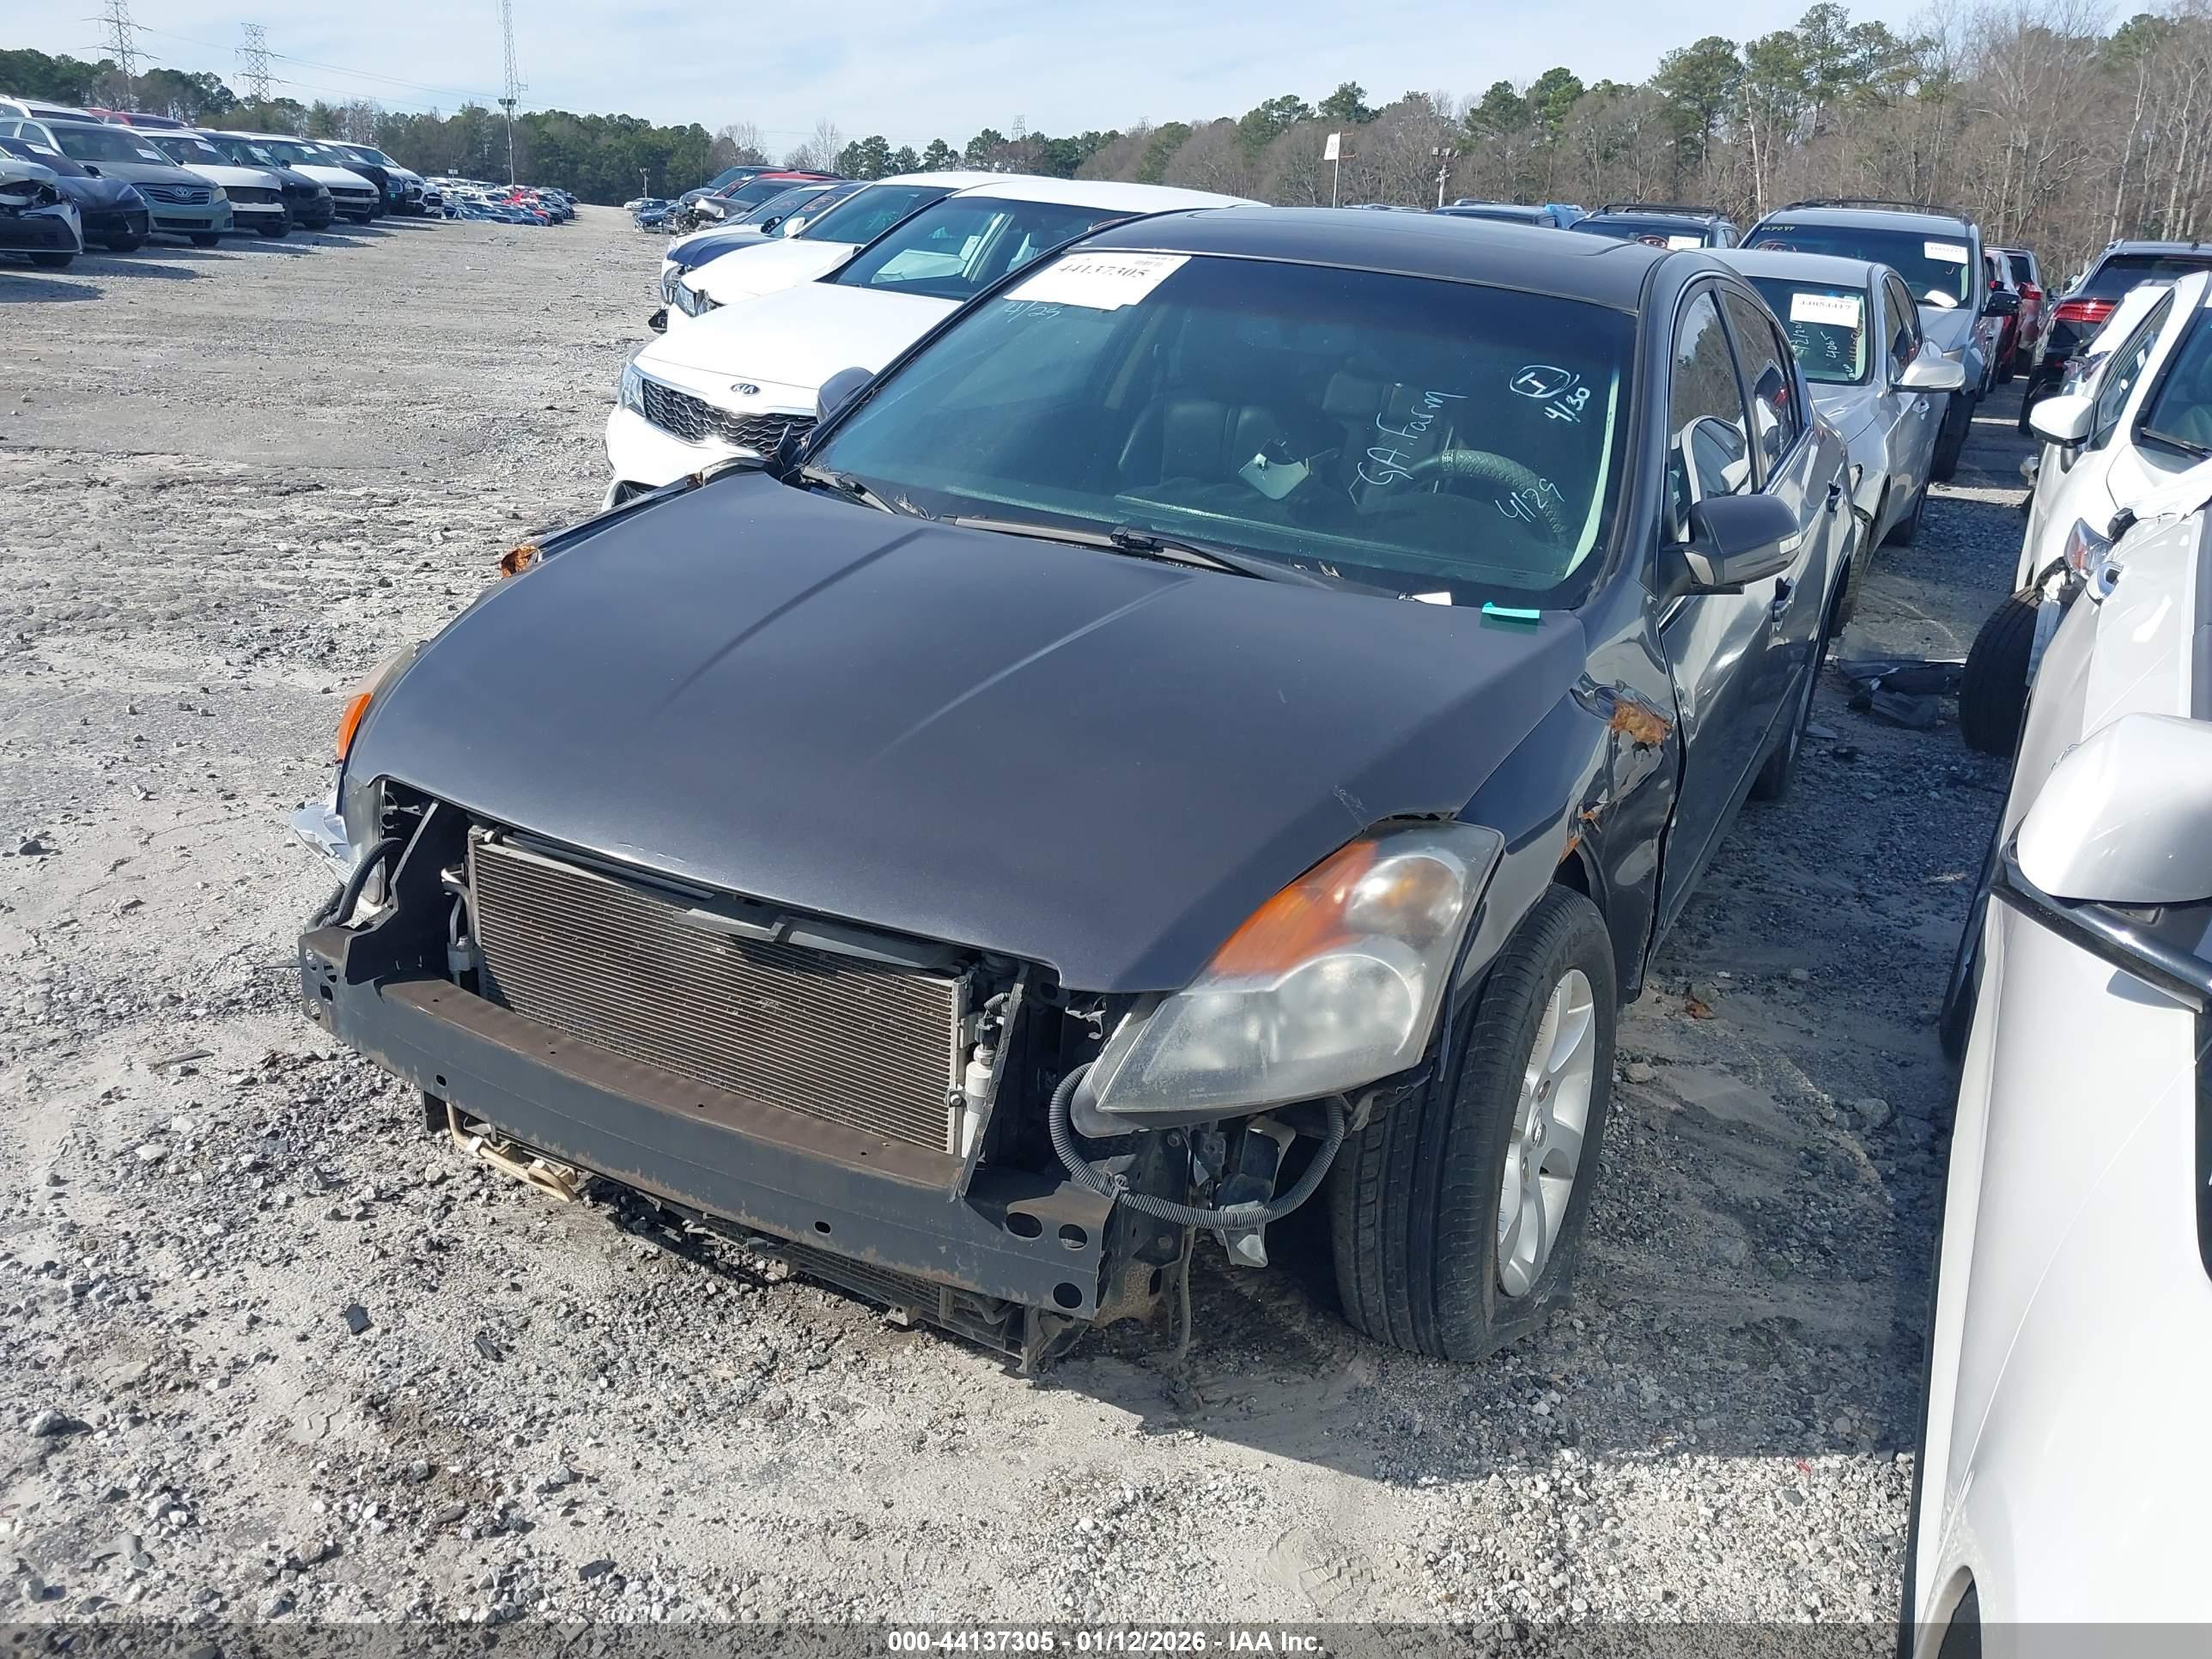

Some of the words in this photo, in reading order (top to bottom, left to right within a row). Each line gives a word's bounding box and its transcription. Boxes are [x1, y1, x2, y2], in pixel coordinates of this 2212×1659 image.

[1058, 264, 1151, 278] 44137305
[732, 383, 756, 395] KIA
[1543, 386, 1592, 423] 4/30
